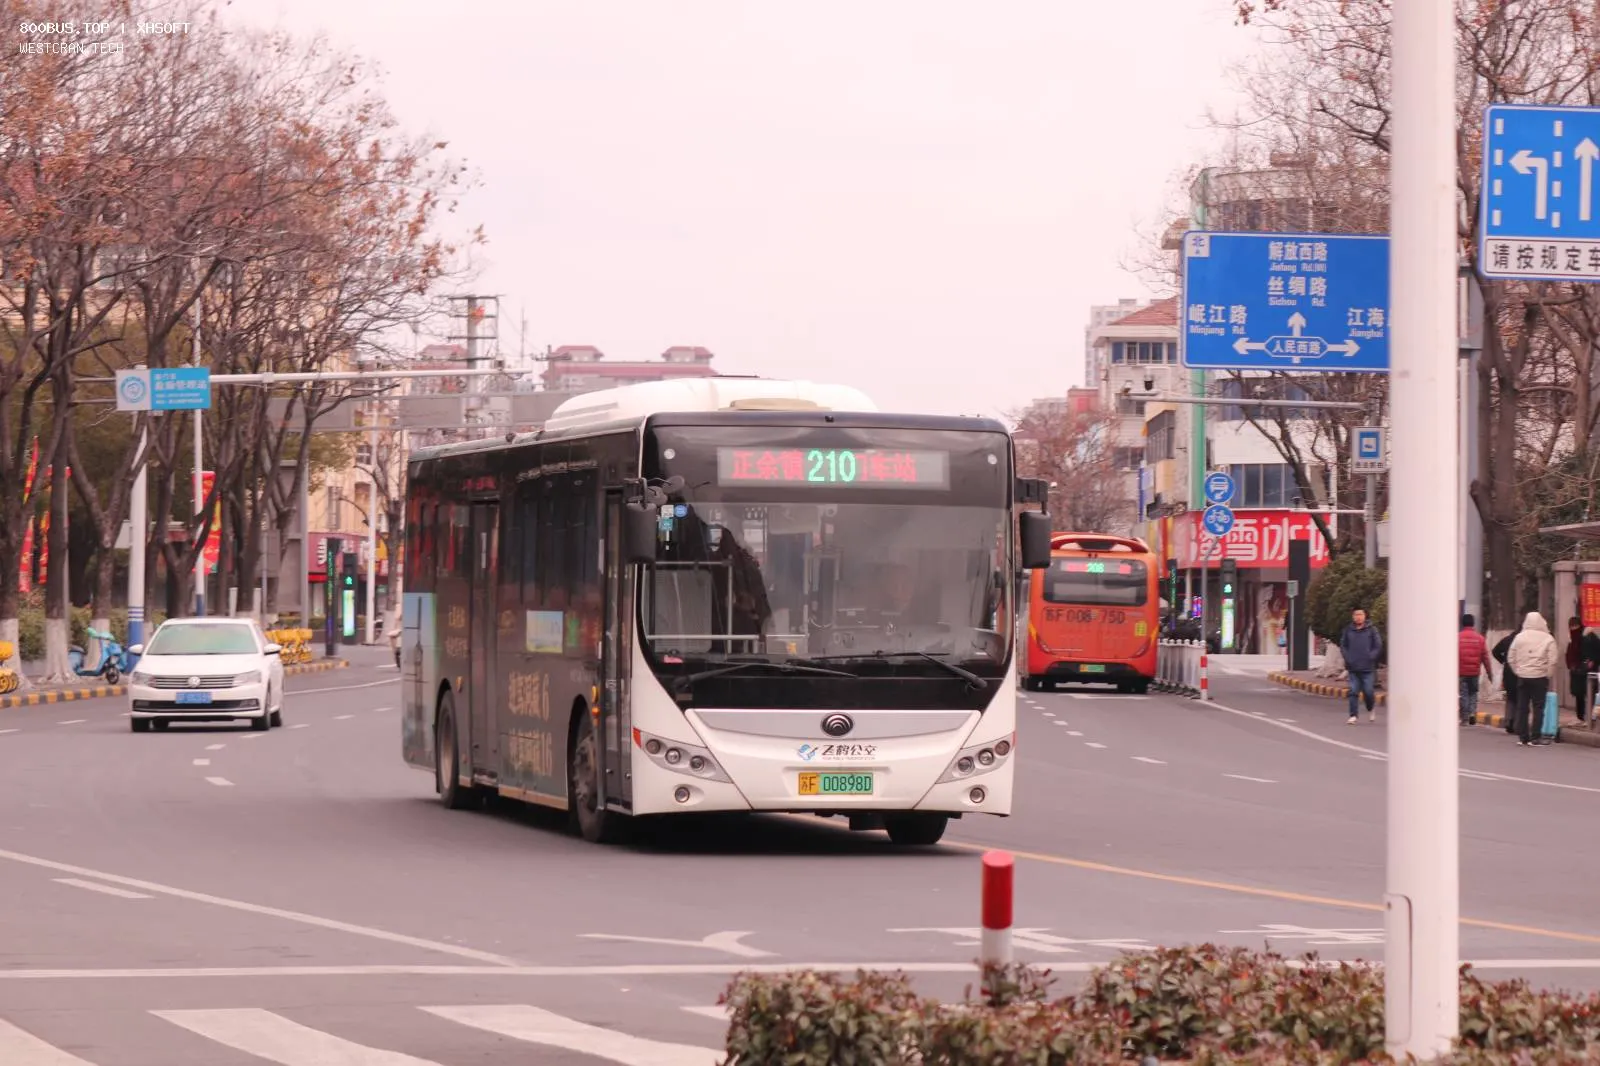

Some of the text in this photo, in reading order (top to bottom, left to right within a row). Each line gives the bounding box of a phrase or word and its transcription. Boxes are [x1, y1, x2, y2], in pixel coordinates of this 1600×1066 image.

[1268, 241, 1328, 262] 解放西路
[1492, 243, 1600, 272] 请按规定车
[1267, 276, 1327, 297] 丝绸路
[1189, 303, 1247, 325] 岷江路
[1271, 340, 1321, 354] 人民西路
[807, 450, 856, 482] 210
[822, 744, 878, 756] 飞鹤公交
[823, 776, 872, 791] 00898D
